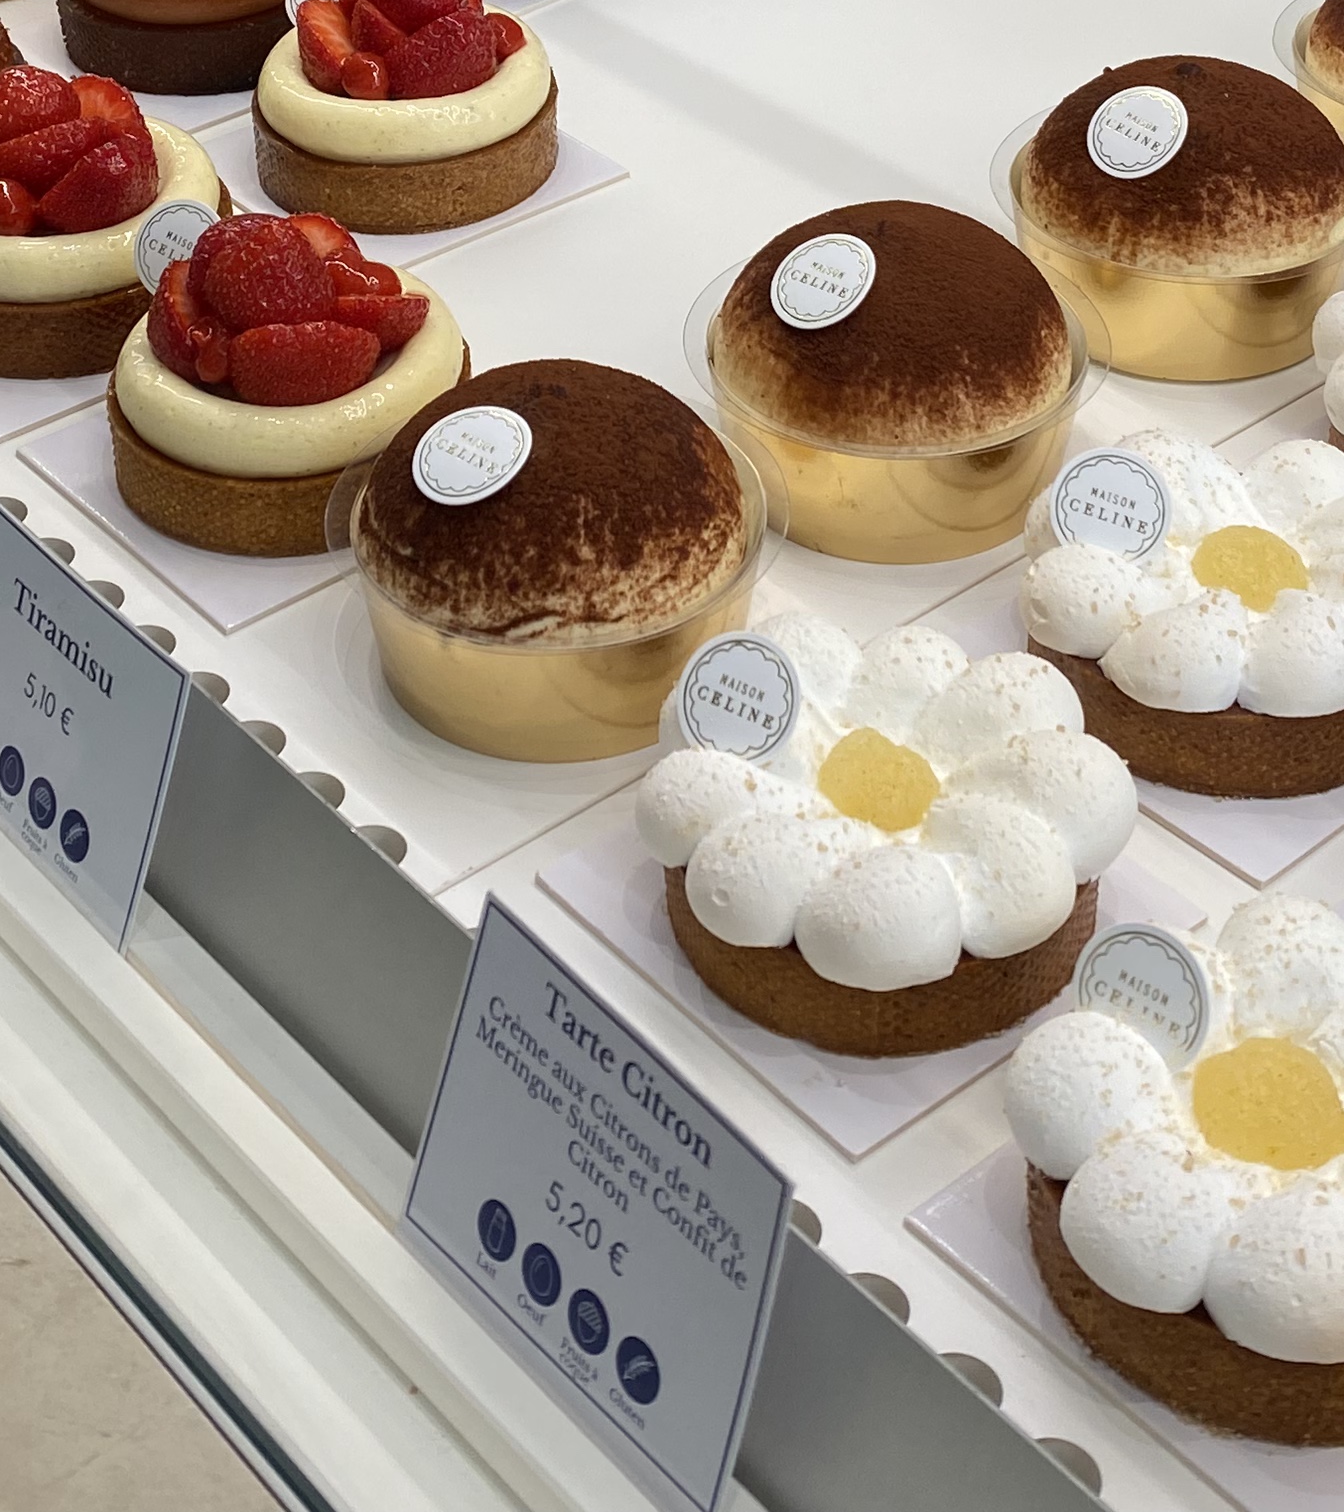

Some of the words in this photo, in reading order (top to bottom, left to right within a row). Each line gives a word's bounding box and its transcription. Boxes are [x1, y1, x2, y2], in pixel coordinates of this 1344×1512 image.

[1105, 118, 1161, 153] CELINE
[1125, 112, 1158, 134] MAISON
[148, 238, 190, 263] CELI
[166, 231, 193, 251] MAISO
[790, 269, 849, 299] CELINE
[812, 261, 846, 280] MAISON
[435, 437, 497, 475] CELINE
[460, 431, 496, 454] MAISON
[1069, 498, 1149, 536] CELINE
[1090, 487, 1137, 511] MAISON
[13, 577, 114, 701] Tiramisu
[24, 672, 56, 719] 5,10
[60, 707, 75, 737] €
[719, 673, 766, 703] MAISON
[697, 685, 775, 731] CELINE
[1094, 979, 1181, 1034] CELINE
[1119, 969, 1170, 1007] MAISON
[545, 981, 615, 1074] Tarte
[621, 1061, 712, 1170] Citron
[489, 995, 549, 1067] Crème
[552, 1061, 587, 1103] aux
[590, 1093, 661, 1175] Citrons
[664, 1167, 690, 1202] de
[694, 1189, 745, 1260] Pays,
[476, 1015, 563, 1115] Meringue
[566, 1103, 626, 1173] Suisse
[628, 1170, 648, 1197] et
[653, 1187, 717, 1263] Confit
[720, 1254, 749, 1292] de
[568, 1140, 629, 1214] Citron
[545, 1180, 603, 1251] 5,20
[607, 1241, 630, 1278] €
[517, 1293, 547, 1327] Oeuf
[560, 1336, 591, 1374] Fruits
[609, 1387, 645, 1431] Gluten
